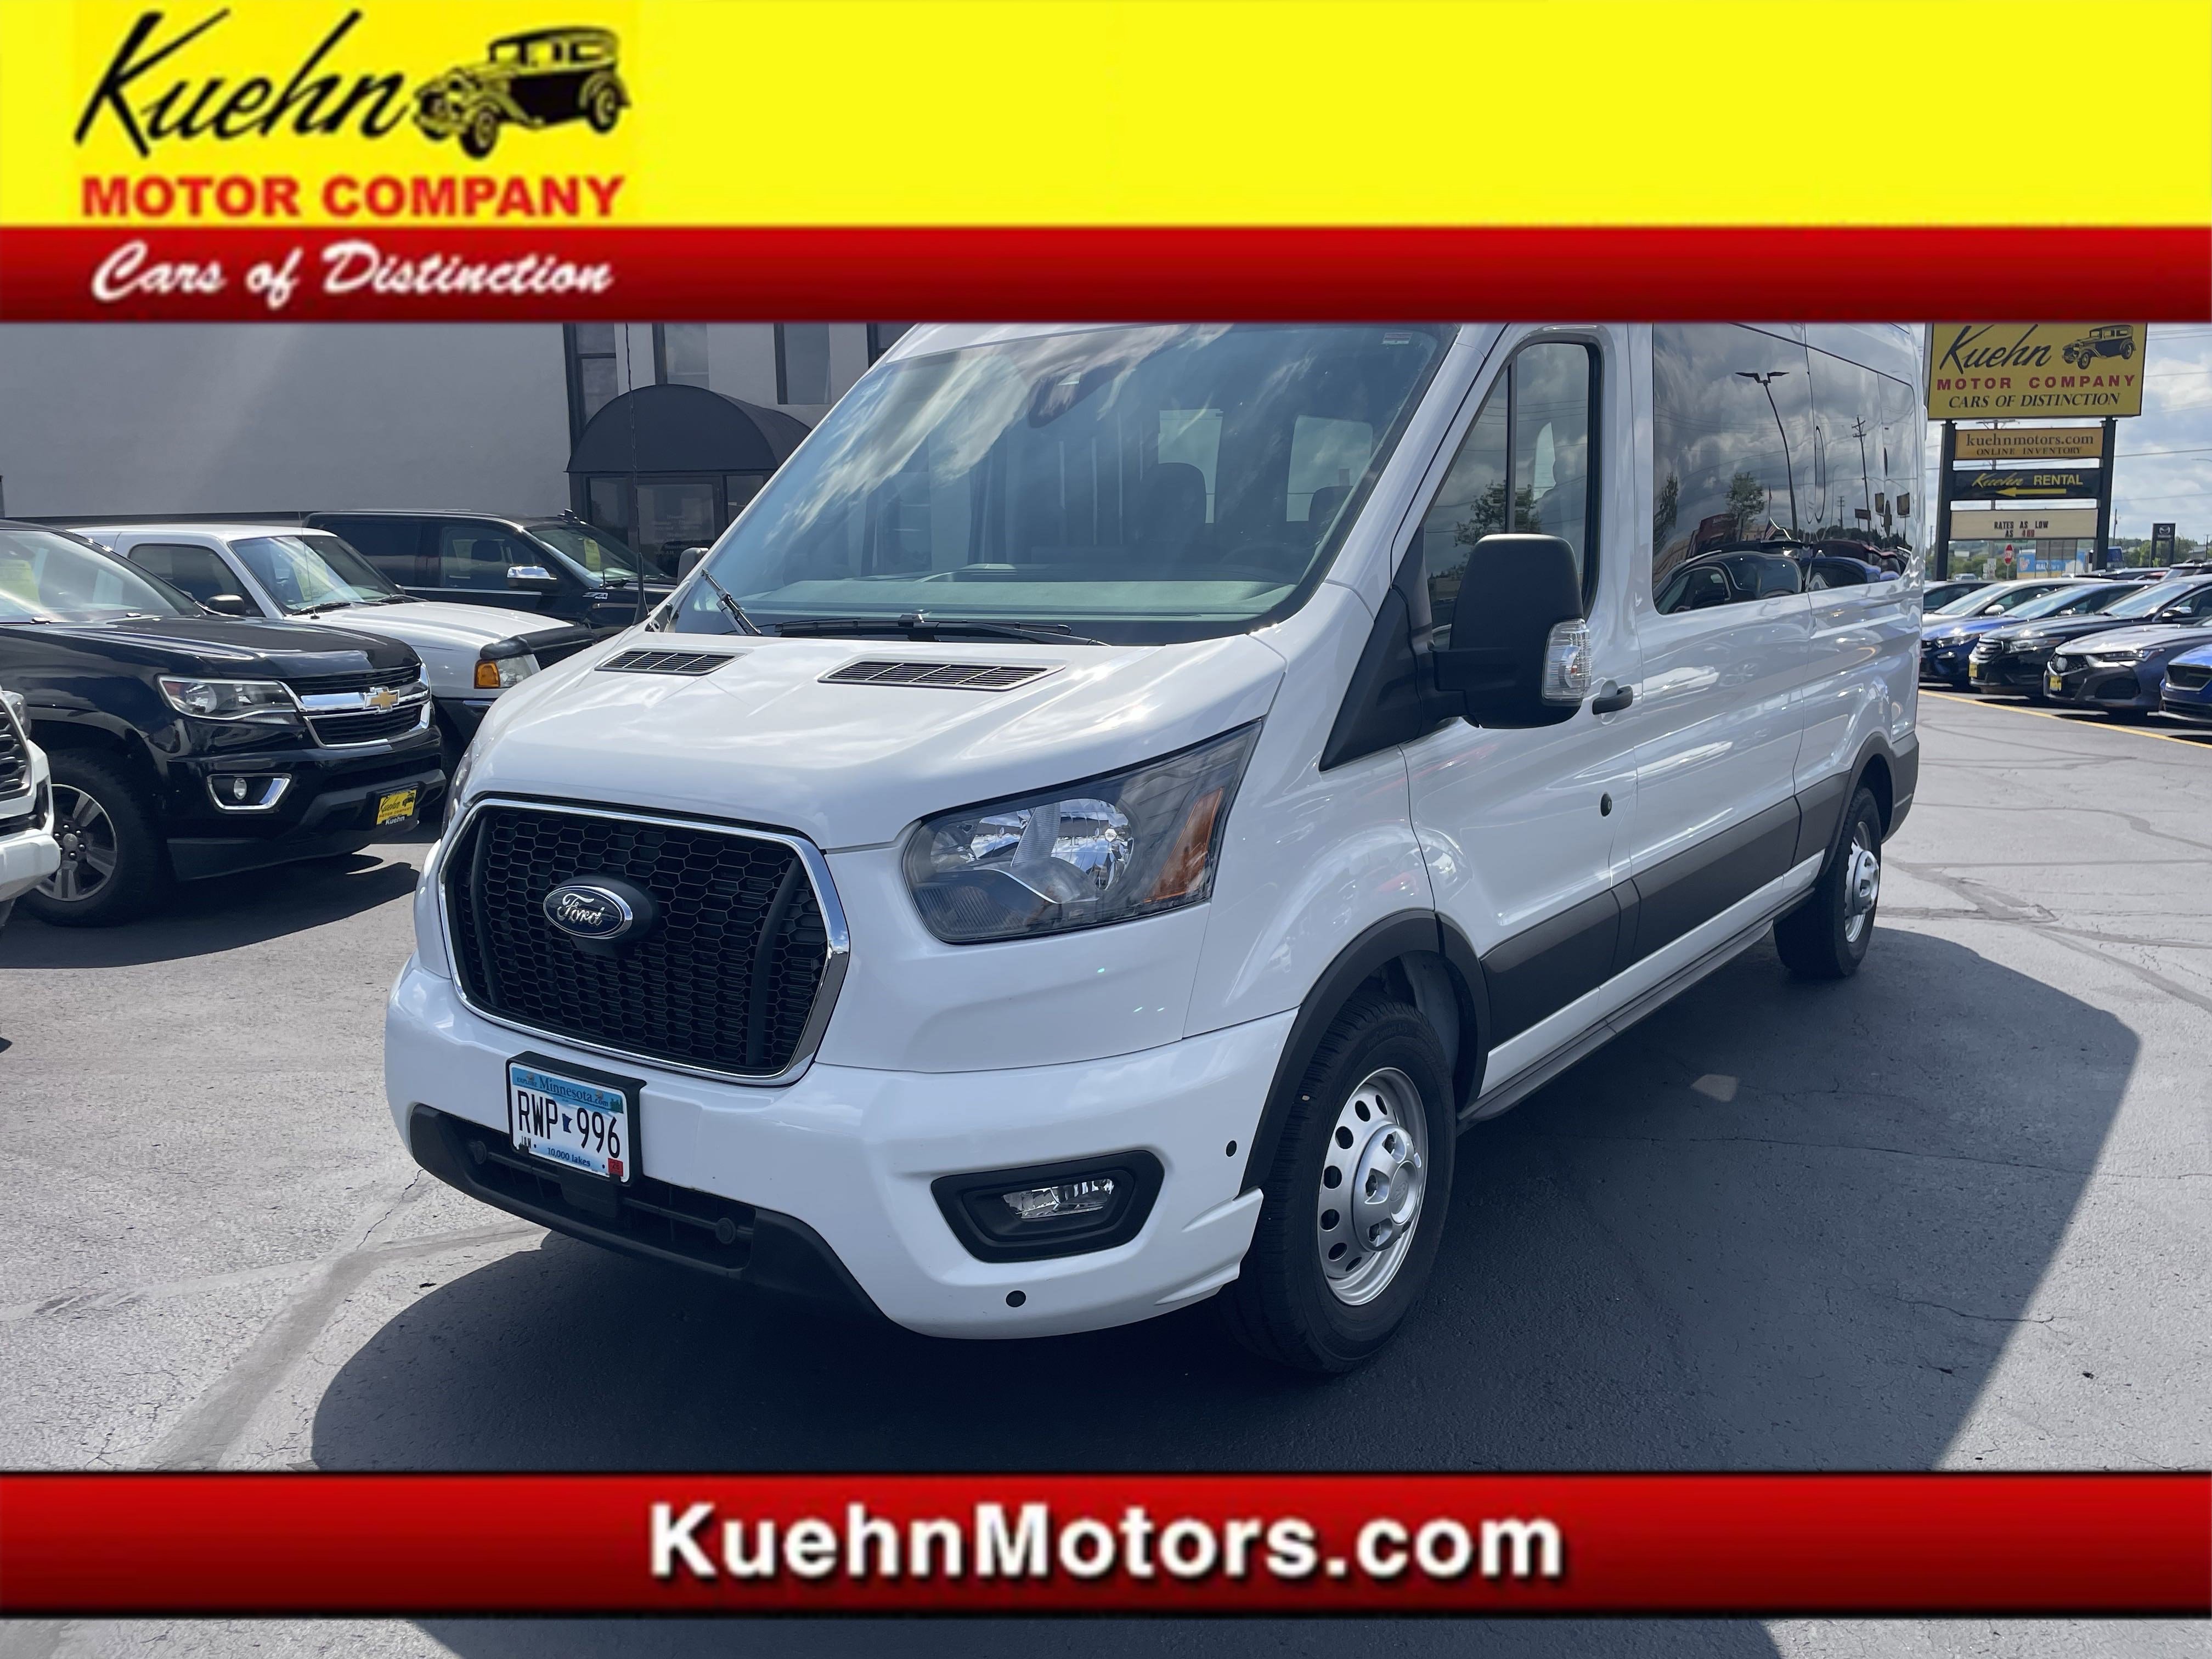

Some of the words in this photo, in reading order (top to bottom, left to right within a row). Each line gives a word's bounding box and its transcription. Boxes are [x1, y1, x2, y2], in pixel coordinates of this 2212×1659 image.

[1939, 324, 2052, 375] Kuehn
[1937, 377, 2011, 391] MOTOR
[2029, 375, 2135, 388] COMPANY
[1949, 395, 1990, 408] CARS
[1995, 394, 2016, 408] OF
[2020, 392, 2120, 407] DISTINCTION
[1966, 433, 2094, 447] kuehnmotors.com
[1976, 447, 2015, 456] ONLINE
[2023, 447, 2083, 455] INVENTORY
[1971, 472, 2024, 488] Kuehn
[2033, 474, 2084, 486] RENTAL
[1994, 521, 2014, 529] RATES
[2019, 521, 2028, 529] AS
[2035, 520, 2049, 529] LOW
[2005, 529, 2013, 538] AS
[385, 816, 405, 825] Kuehn
[557, 892, 606, 926] Ford
[517, 1090, 558, 1139] RWP
[577, 1107, 620, 1159] 996
[548, 1147, 570, 1160] 10,000
[572, 1153, 591, 1167] lakes
